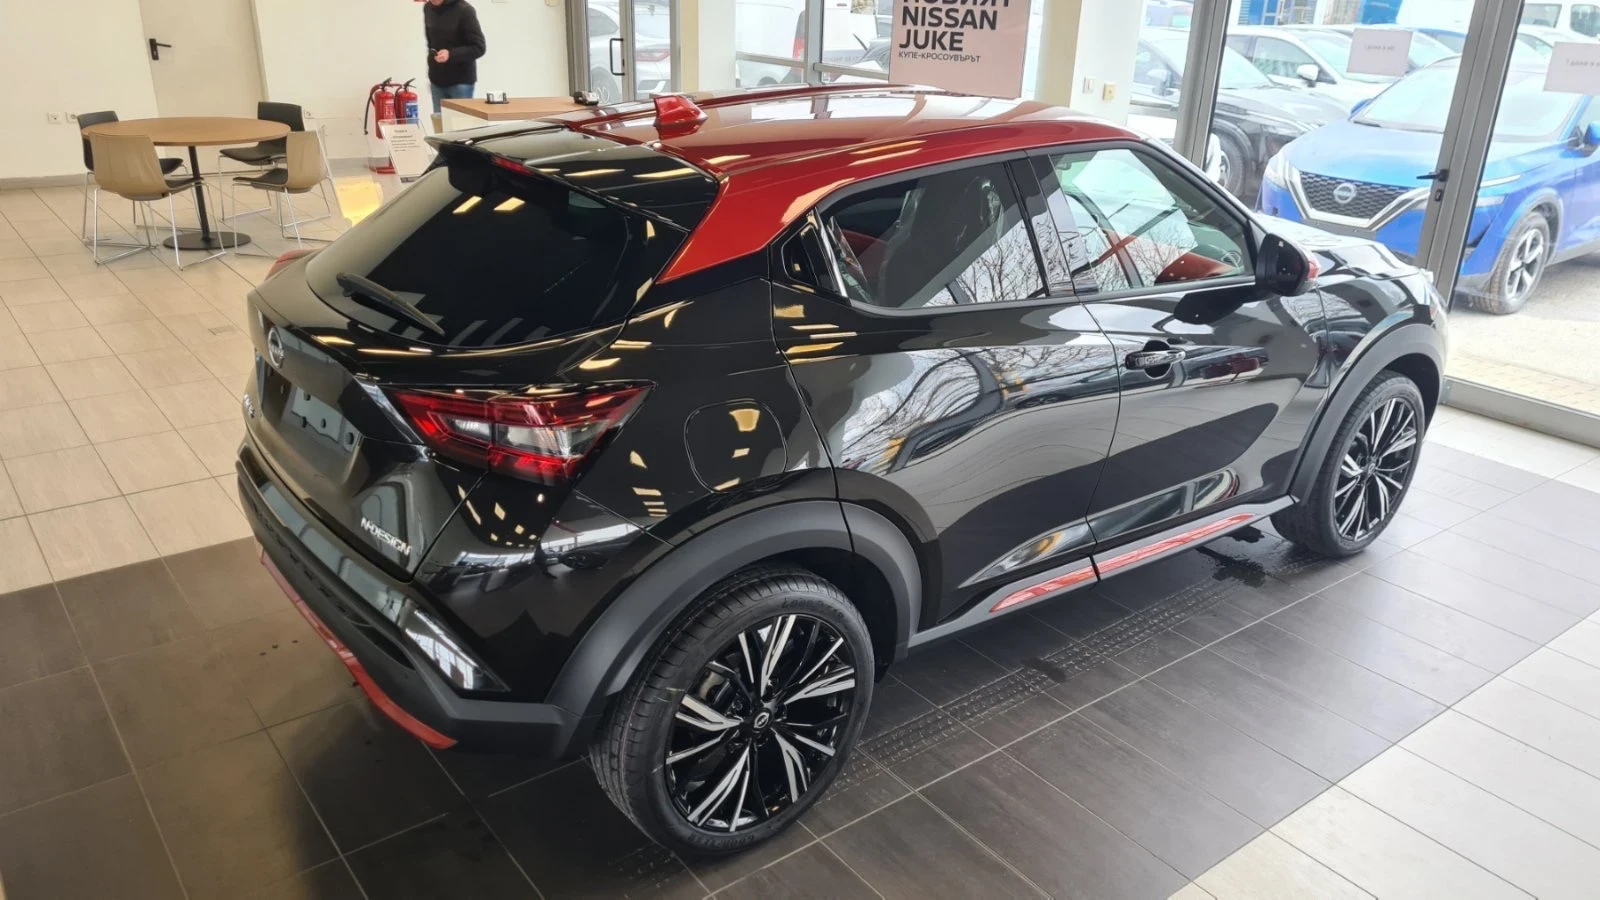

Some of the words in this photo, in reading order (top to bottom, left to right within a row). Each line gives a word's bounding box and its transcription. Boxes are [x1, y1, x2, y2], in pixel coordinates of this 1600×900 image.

[902, 6, 998, 30] NISSAN
[899, 29, 965, 51] JUKE
[898, 51, 981, 63] КУПЕ-КРОСОУВЪРЪТ
[360, 516, 413, 556] N-DESIGN
